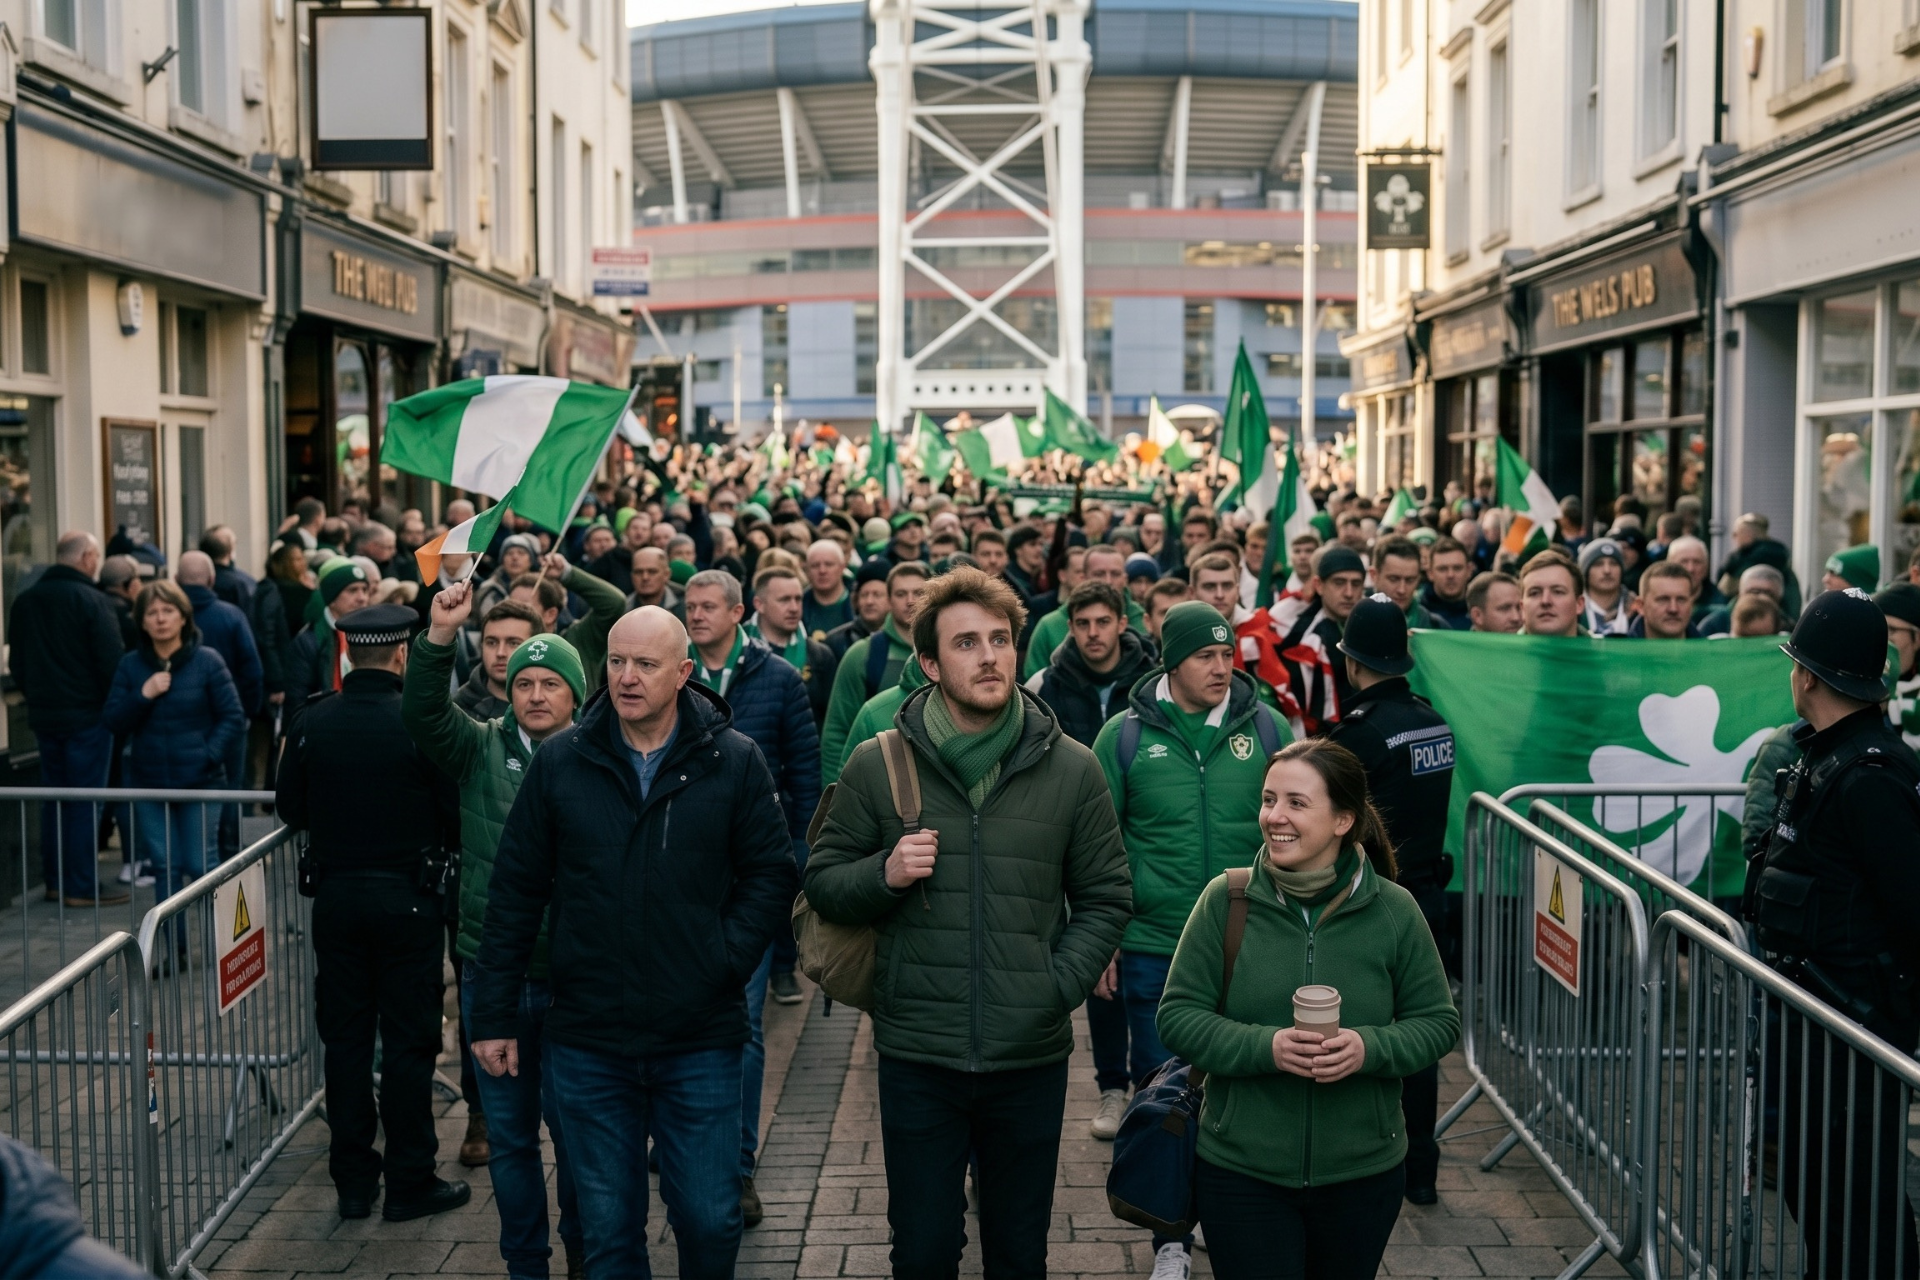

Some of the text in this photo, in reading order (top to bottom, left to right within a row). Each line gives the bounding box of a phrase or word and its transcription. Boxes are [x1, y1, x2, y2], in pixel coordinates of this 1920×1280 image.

[333, 249, 363, 299] THE
[1551, 286, 1579, 328] THE
[1621, 263, 1655, 311] PUB
[1414, 741, 1454, 770] POLICE
